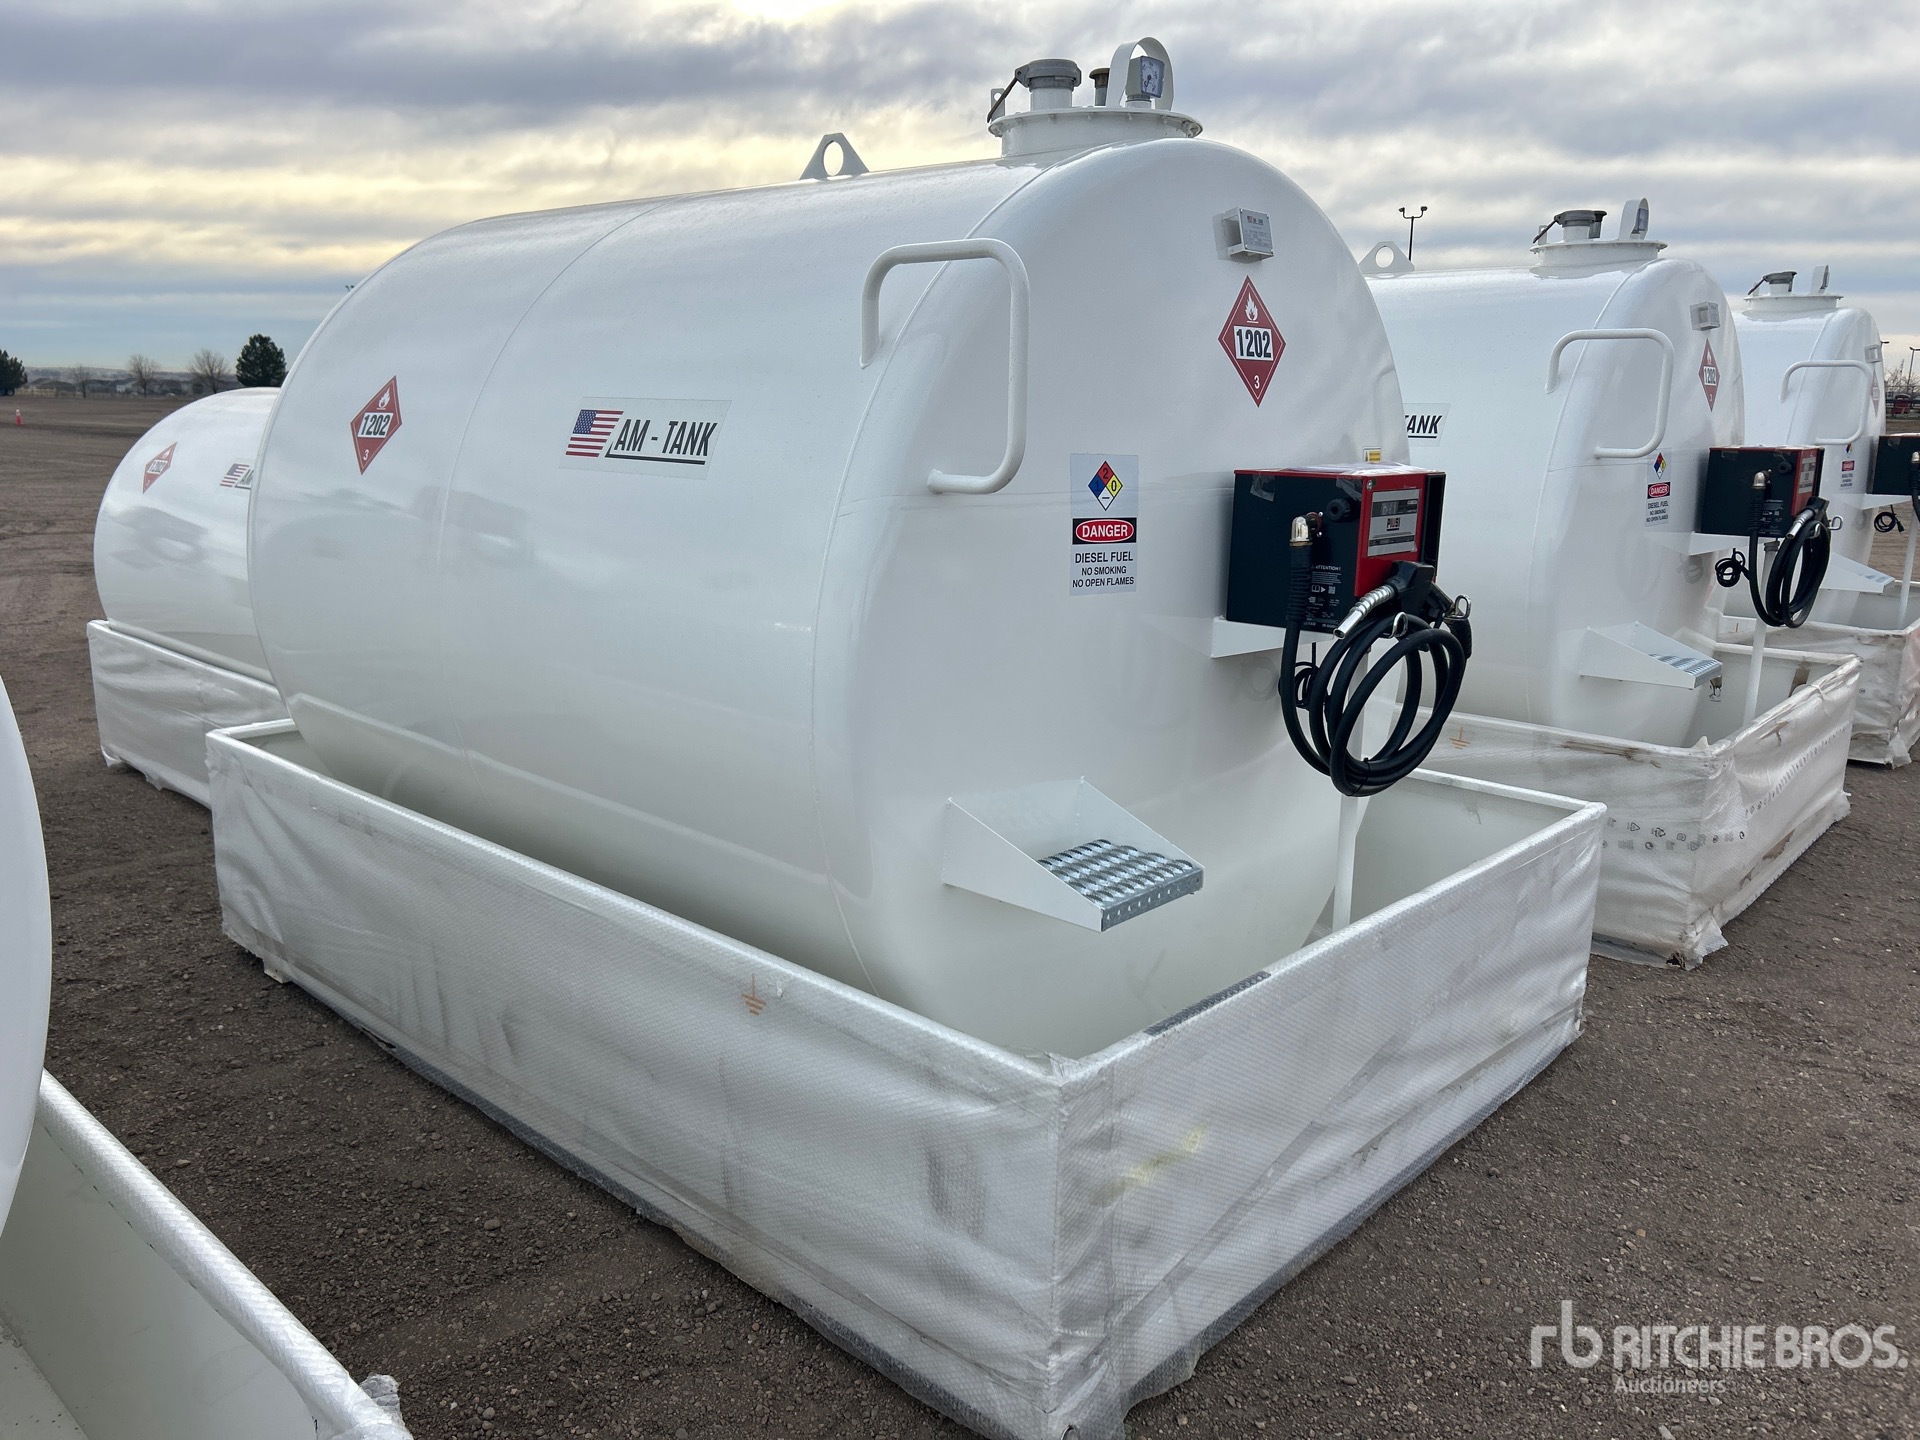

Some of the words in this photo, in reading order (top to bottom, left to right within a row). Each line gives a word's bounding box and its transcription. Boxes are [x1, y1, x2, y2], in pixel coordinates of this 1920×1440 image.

[1236, 328, 1272, 358] 1202
[1254, 375, 1260, 389] 3
[360, 414, 391, 436] 1202
[613, 419, 651, 452] AM
[662, 420, 718, 456] TANK
[363, 449, 369, 460] 3
[1103, 468, 1109, 479] 2
[1111, 480, 1117, 492] 0
[1082, 524, 1128, 538] DANGER
[1075, 552, 1108, 564] DIESEL
[1110, 551, 1133, 562] FUEL
[1081, 567, 1093, 576] NO
[1094, 565, 1127, 575] SMOKING
[1072, 578, 1084, 588] NO
[1085, 577, 1105, 587] OPEN
[1107, 576, 1134, 586] FLAMES
